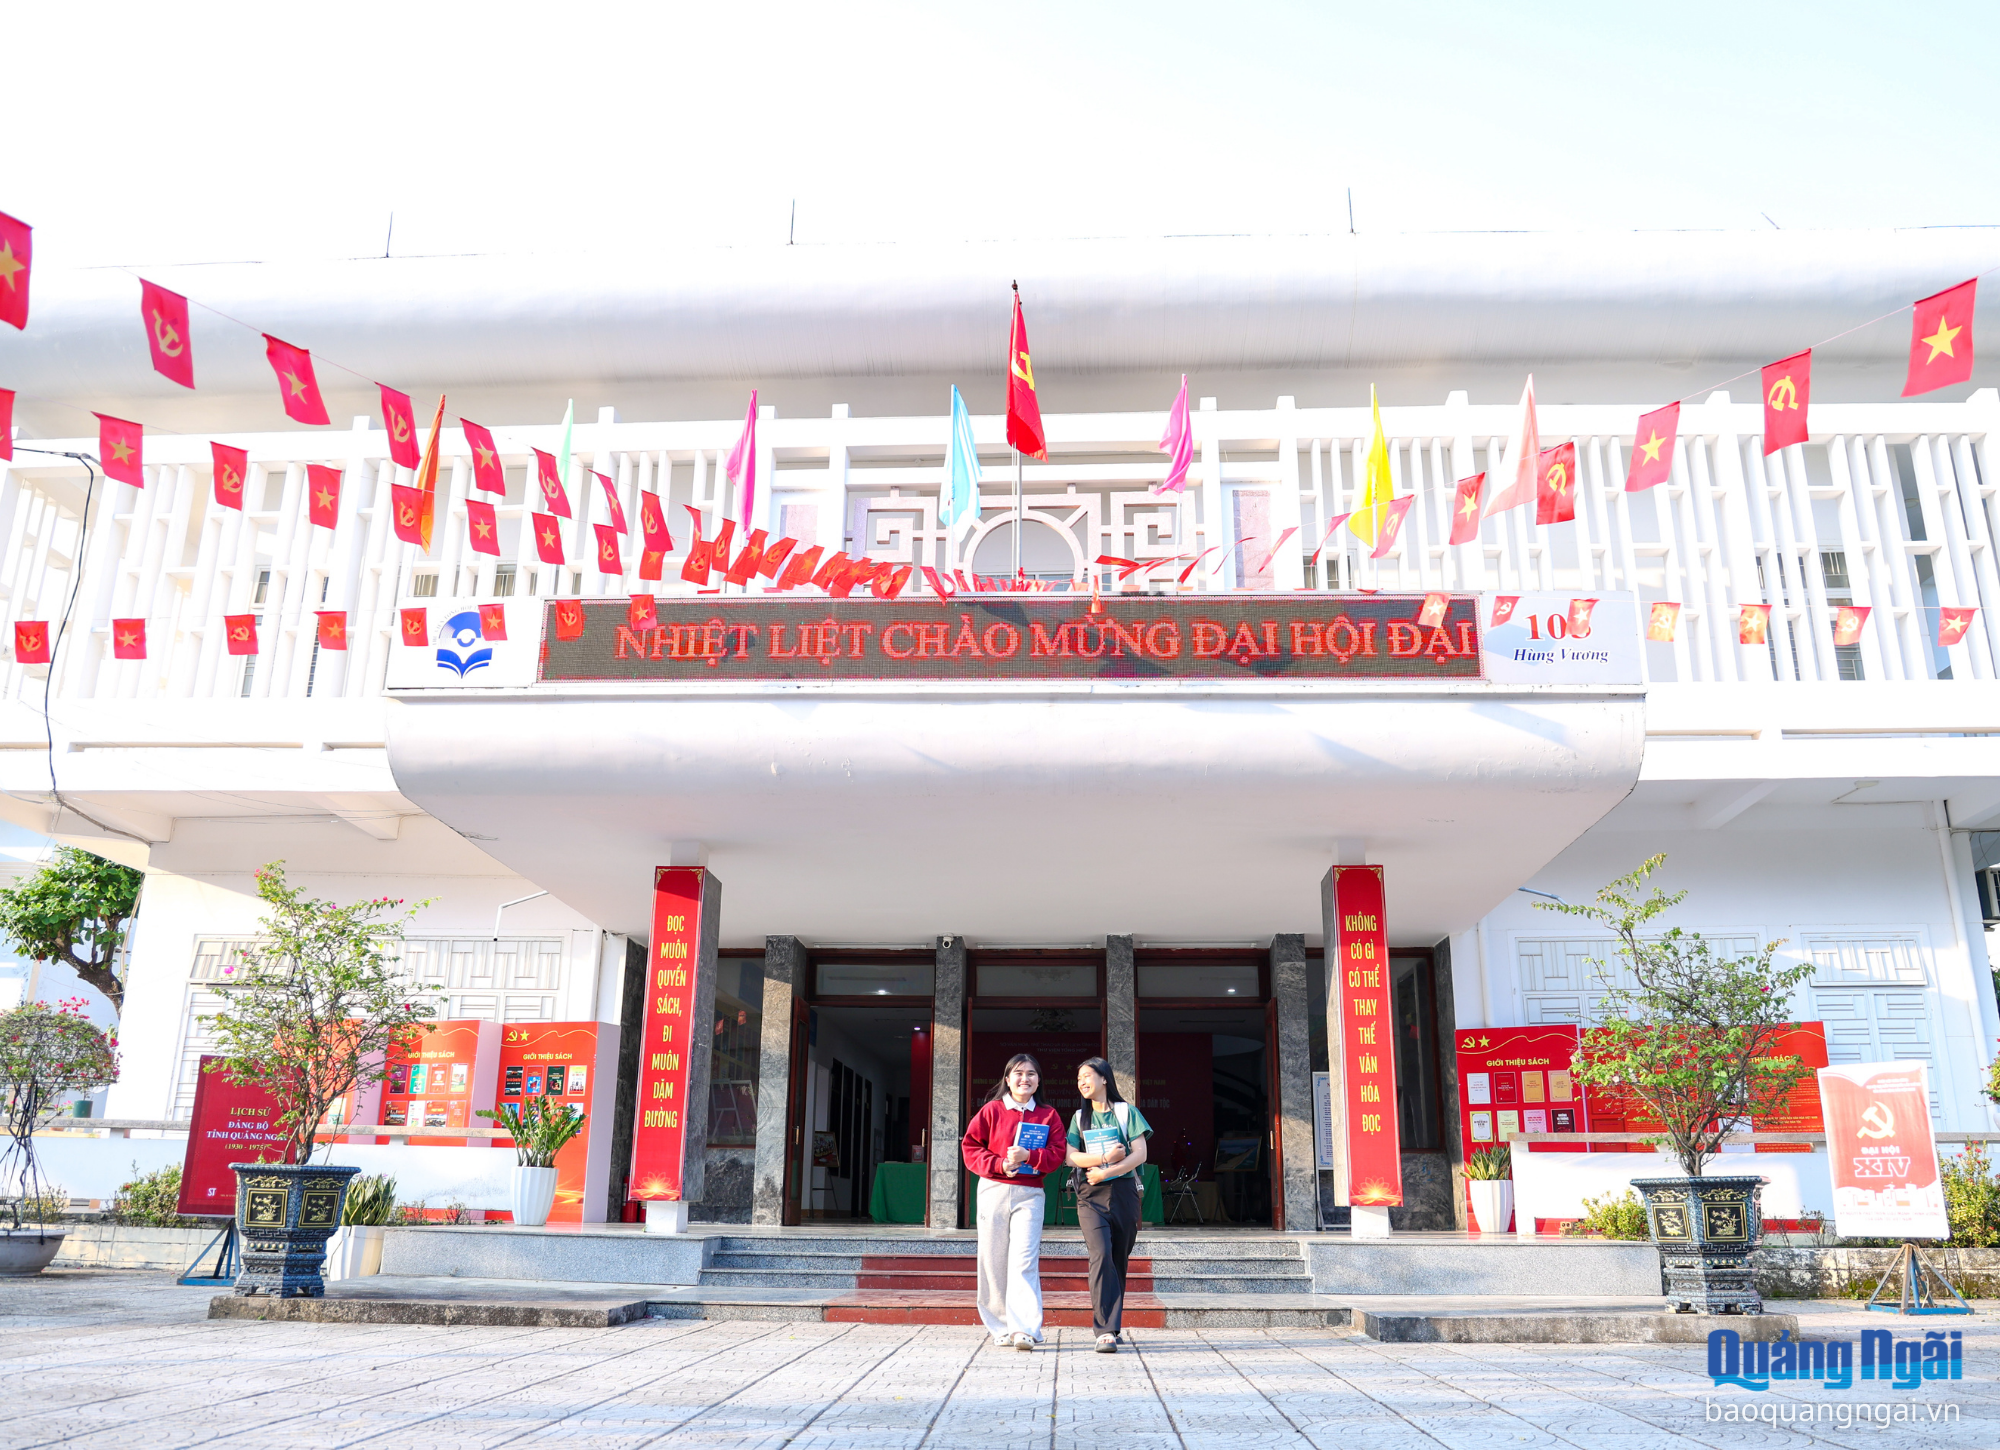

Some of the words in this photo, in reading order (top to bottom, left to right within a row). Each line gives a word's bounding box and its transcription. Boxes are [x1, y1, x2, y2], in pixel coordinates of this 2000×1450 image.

[615, 618, 758, 666] NHIỆT
[769, 618, 872, 665] LIỆT
[882, 613, 1020, 658] CHÀO
[1029, 613, 1181, 658] MỪNG
[1193, 621, 1278, 664] ĐẠI
[1291, 614, 1376, 664] HỘI
[1387, 621, 1477, 664] ĐẠI
[1514, 648, 1555, 664] Hùng
[1561, 648, 1609, 664] Vương
[666, 914, 685, 934] ĐỌC
[1345, 913, 1377, 932] KHÔNG
[660, 941, 688, 959] MUÔN
[1350, 939, 1363, 960] CÓ
[1364, 939, 1375, 960] GÌ
[656, 963, 687, 989] QUYỂN
[1348, 966, 1361, 988] CÓ
[1362, 963, 1381, 988] THỂ
[656, 994, 682, 1017] SÁCH,
[1353, 998, 1378, 1016] THAY
[662, 1025, 673, 1043] ĐI
[1357, 1021, 1377, 1045] THẾ
[438, 1049, 455, 1058] SÁCH
[523, 1052, 537, 1060] GIỚI
[538, 1052, 554, 1062] THIỆU
[554, 1051, 573, 1060] SÁCH
[651, 1050, 680, 1071] MUÔN
[1358, 1052, 1378, 1074] VĂN
[1486, 1058, 1504, 1067] GIỚI
[1504, 1057, 1526, 1068] THIỆU
[1527, 1057, 1550, 1066] SÁCH
[652, 1079, 674, 1102] DẶM
[1360, 1080, 1380, 1103] HÓA
[230, 1107, 255, 1117] LỊCH
[257, 1106, 271, 1117] SỬ
[644, 1106, 678, 1128] ĐƯỜNG
[206, 1129, 229, 1139] TỈNH
[230, 1130, 263, 1140] QUẢNG
[228, 1119, 254, 1129] ĐẢNG
[256, 1120, 269, 1131] BỘ
[1362, 1113, 1382, 1136] ĐỌC
[1860, 1146, 1879, 1156] ĐẠI
[1881, 1144, 1900, 1156] HỘI
[1853, 1156, 1911, 1178] XIV
[207, 1187, 217, 1197] ST
